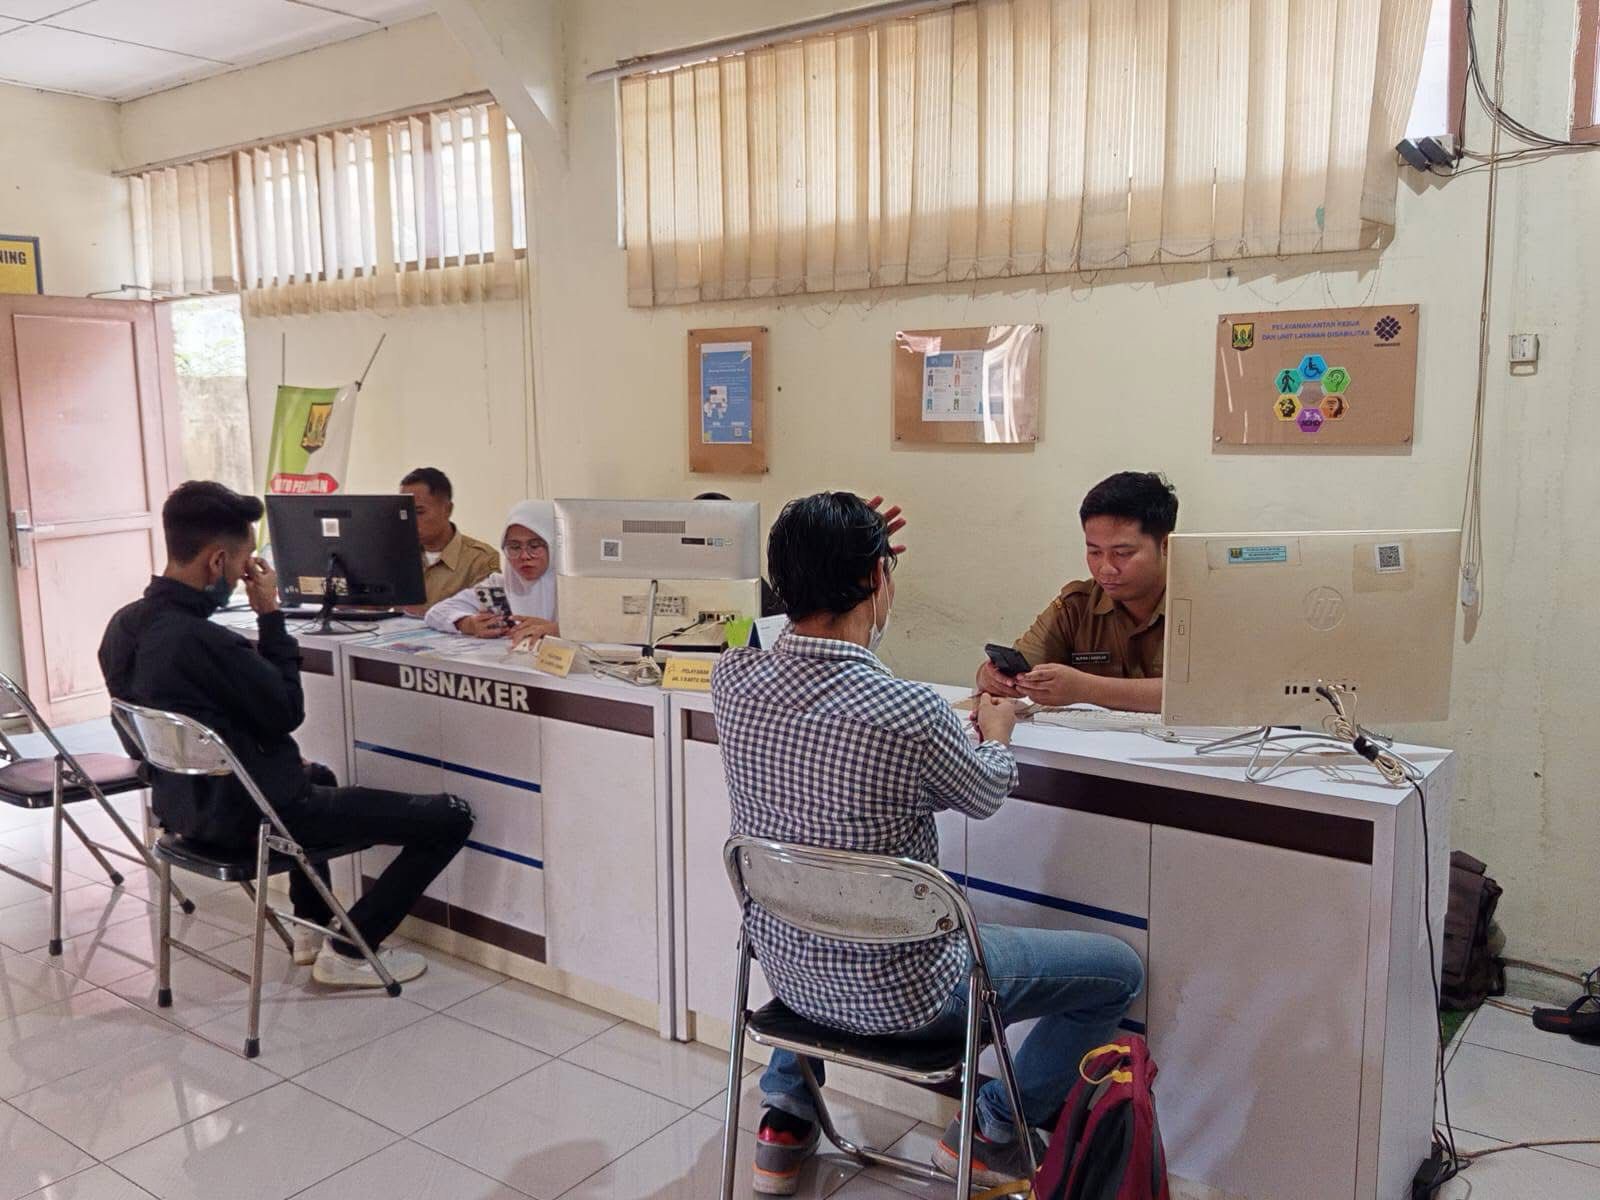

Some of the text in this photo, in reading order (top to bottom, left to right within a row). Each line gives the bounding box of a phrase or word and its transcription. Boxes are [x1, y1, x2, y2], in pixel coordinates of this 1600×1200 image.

[1271, 322, 1311, 330] PELAYANAN
[1262, 333, 1276, 341] DAN
[1277, 332, 1293, 340] UNIT
[1327, 330, 1370, 338] DISABILITAS
[399, 665, 530, 711] DISNAKER
